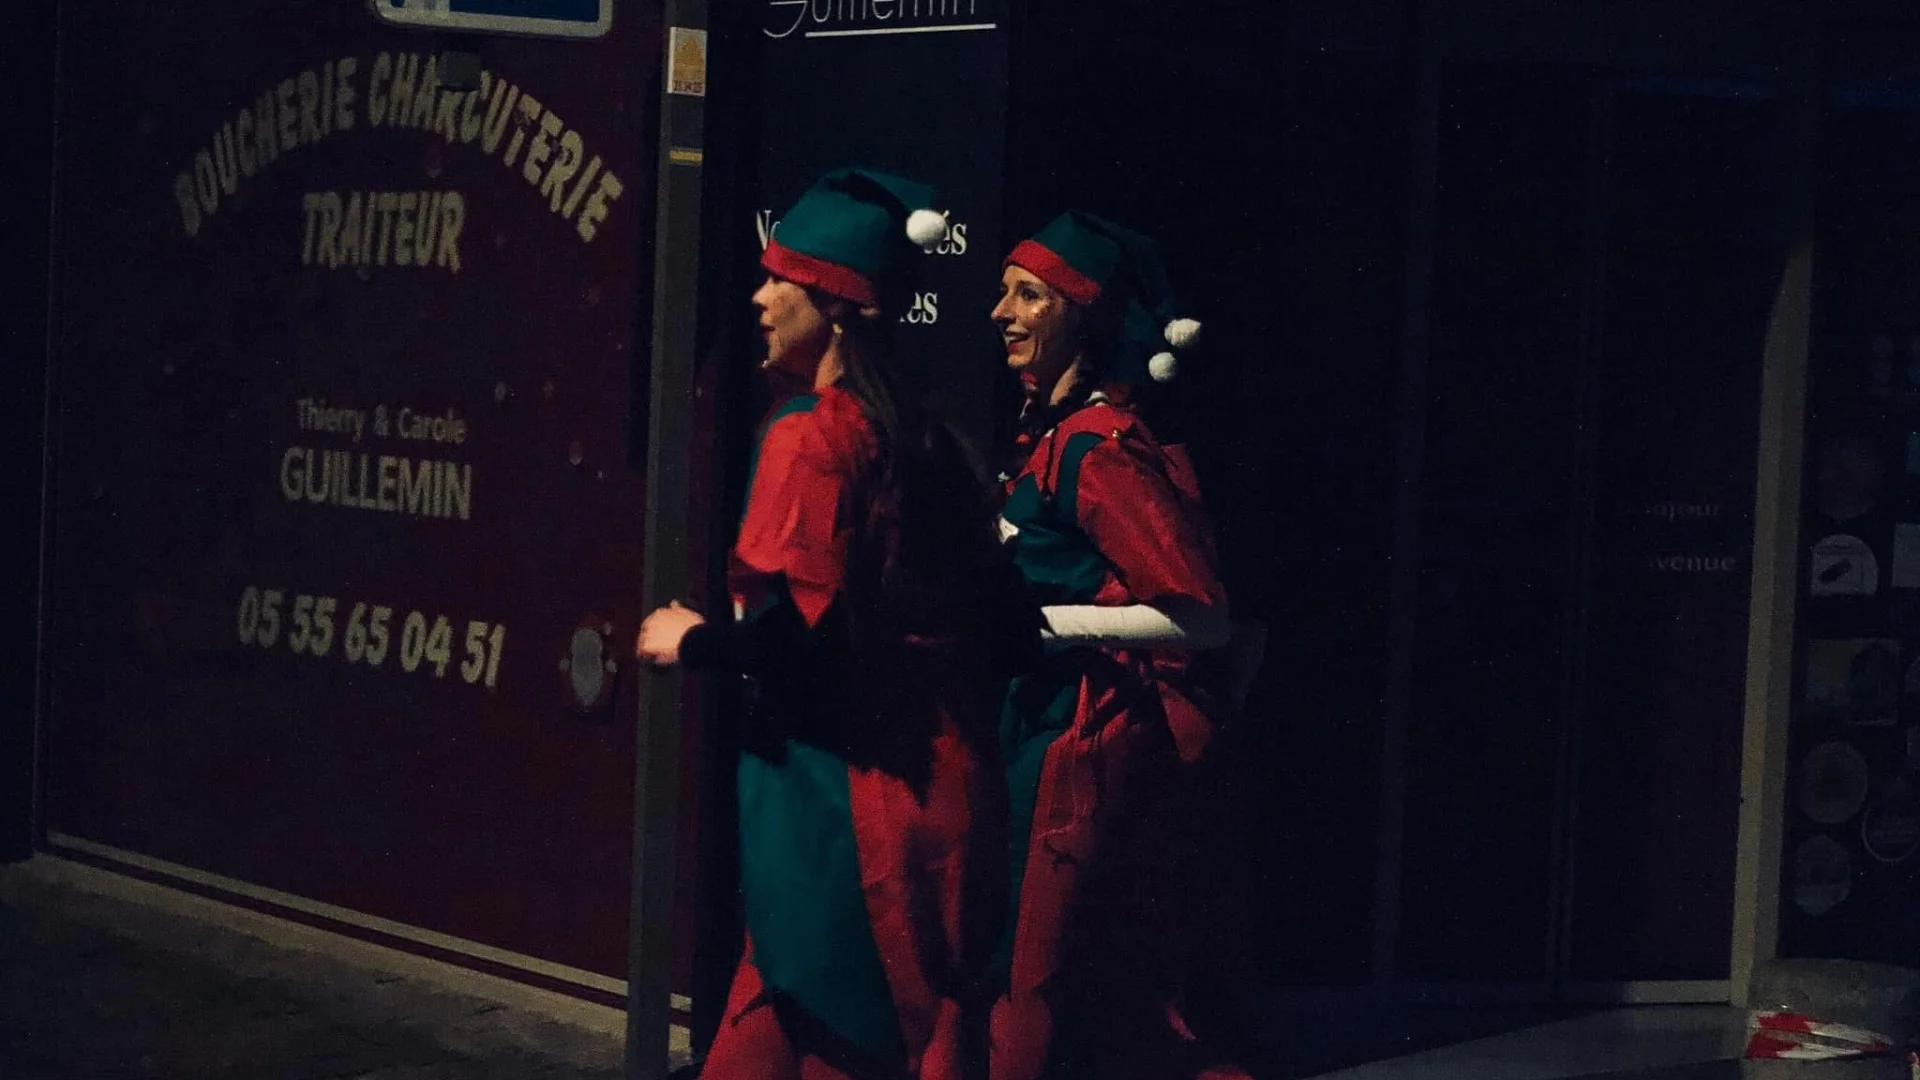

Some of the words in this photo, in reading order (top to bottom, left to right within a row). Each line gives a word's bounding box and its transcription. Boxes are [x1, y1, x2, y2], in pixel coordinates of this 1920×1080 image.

[173, 56, 358, 237] BOUCHERIE
[301, 190, 467, 274] TRAITEUR
[296, 397, 366, 443] Thierry
[374, 405, 390, 437] &
[397, 407, 468, 445] Carole
[280, 446, 472, 521] GUILLEMIN
[237, 585, 284, 649] 05
[289, 594, 337, 657] 55
[345, 602, 393, 665] 65
[401, 610, 456, 678] 04
[461, 620, 507, 688] 51
